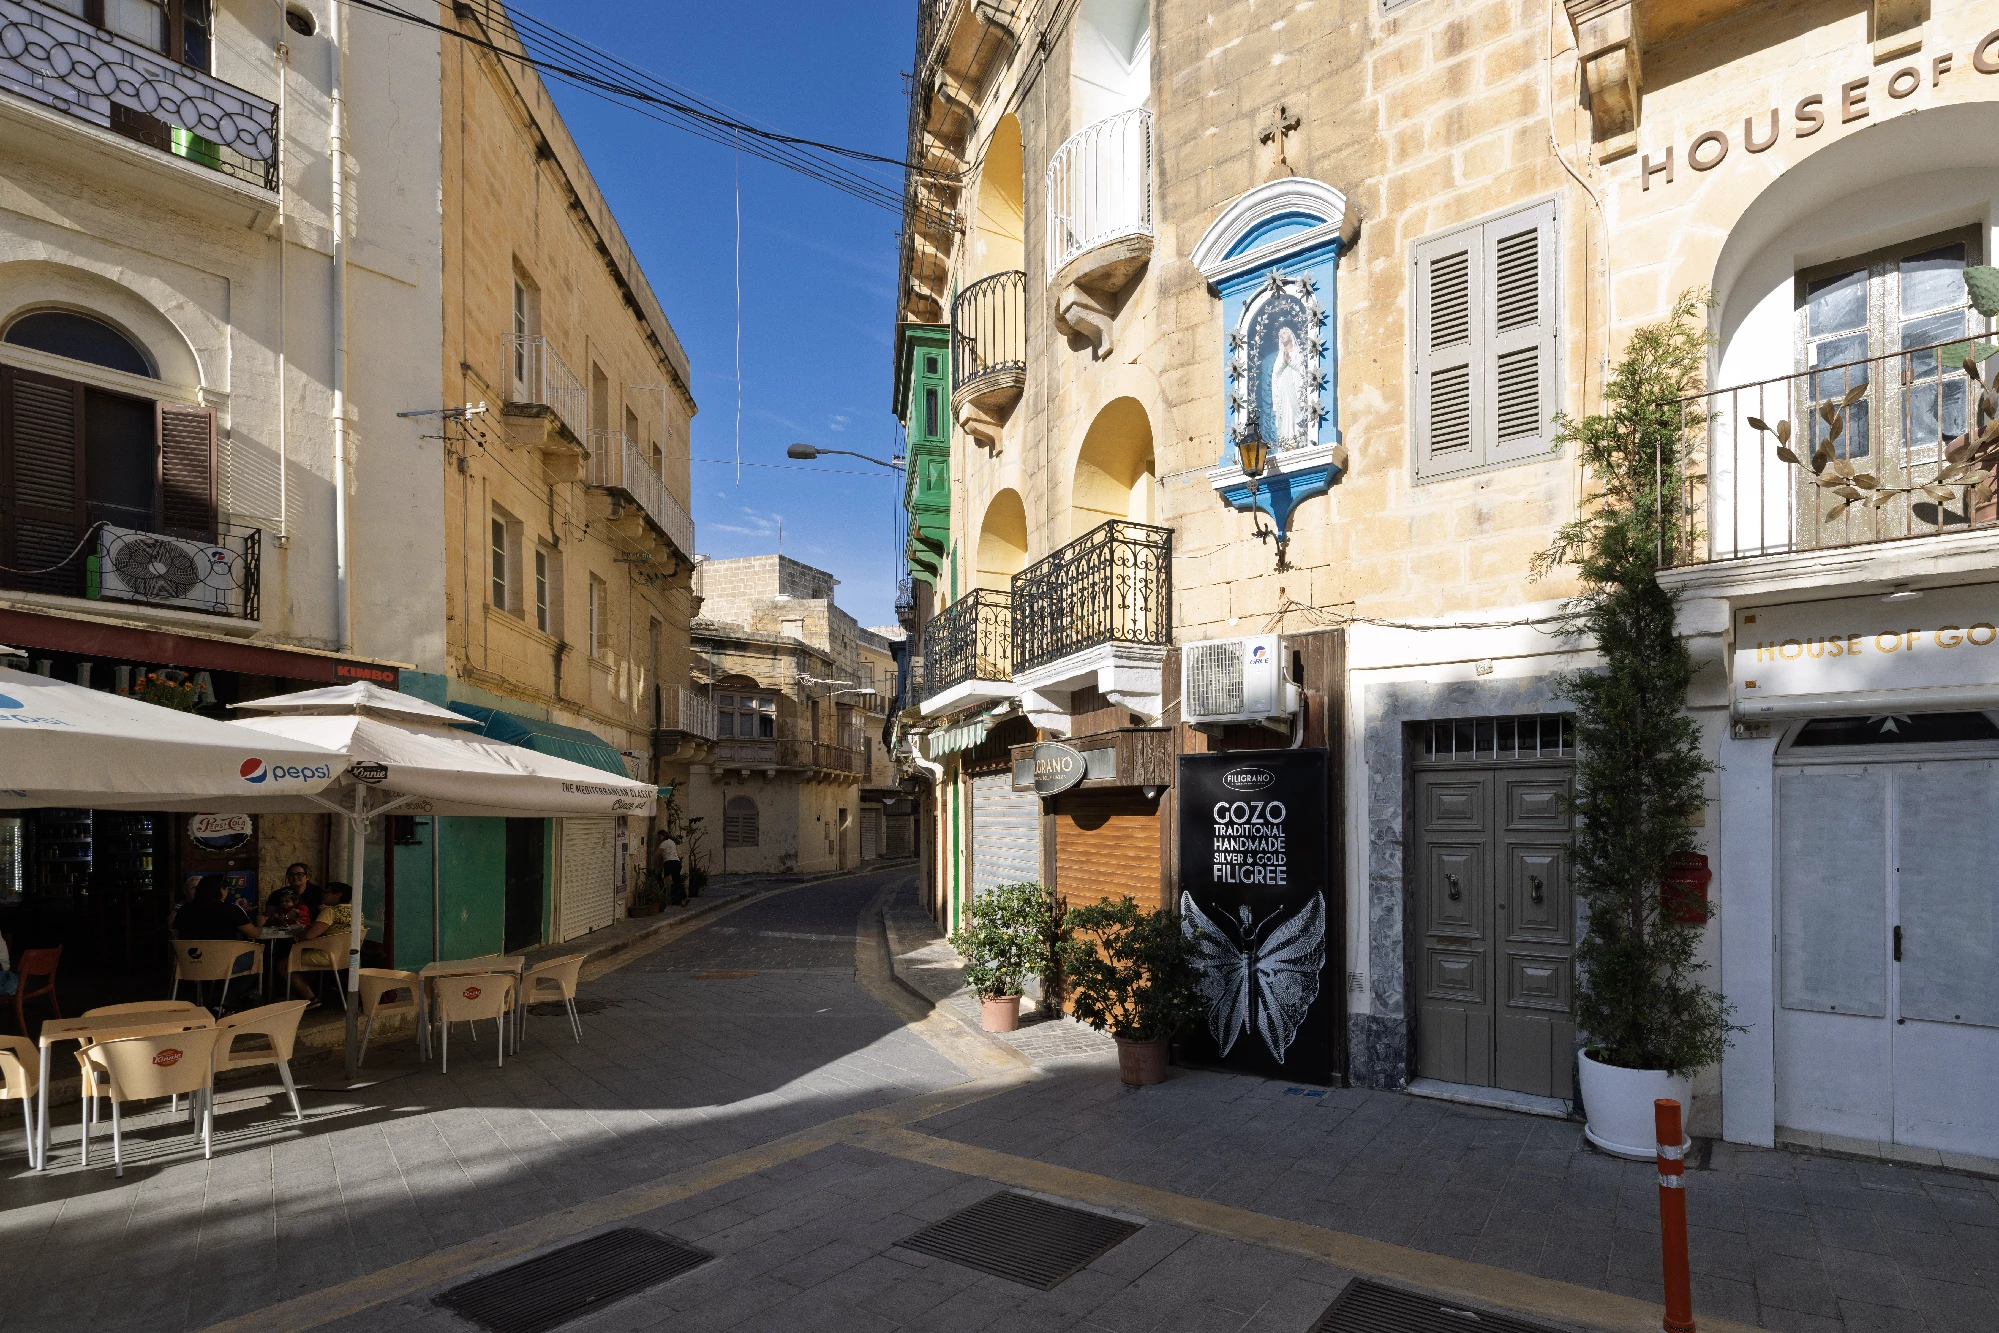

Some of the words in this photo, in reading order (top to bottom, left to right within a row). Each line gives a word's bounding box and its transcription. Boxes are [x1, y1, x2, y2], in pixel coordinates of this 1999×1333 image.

[1641, 75, 1870, 192] HOUSE
[1887, 52, 1953, 99] OF
[1757, 633, 1862, 662] HOUSE
[1875, 628, 1921, 653] OF
[1934, 622, 1997, 648] GO
[337, 665, 394, 682] KIMBO
[272, 764, 332, 783] pepsi
[353, 767, 386, 778] Kinnie
[1227, 774, 1270, 783] FILIGRANO
[562, 782, 574, 793] THE
[576, 785, 629, 797] MEDITERRANEAN
[1213, 801, 1287, 823] GOZO
[1213, 825, 1286, 837] TRADITIONAL
[1213, 838, 1286, 851] HANDMADE
[1213, 853, 1244, 864] SILVER
[1247, 854, 1254, 864] &
[1256, 853, 1287, 865] GOLD
[1213, 865, 1287, 885] FILIGREE
